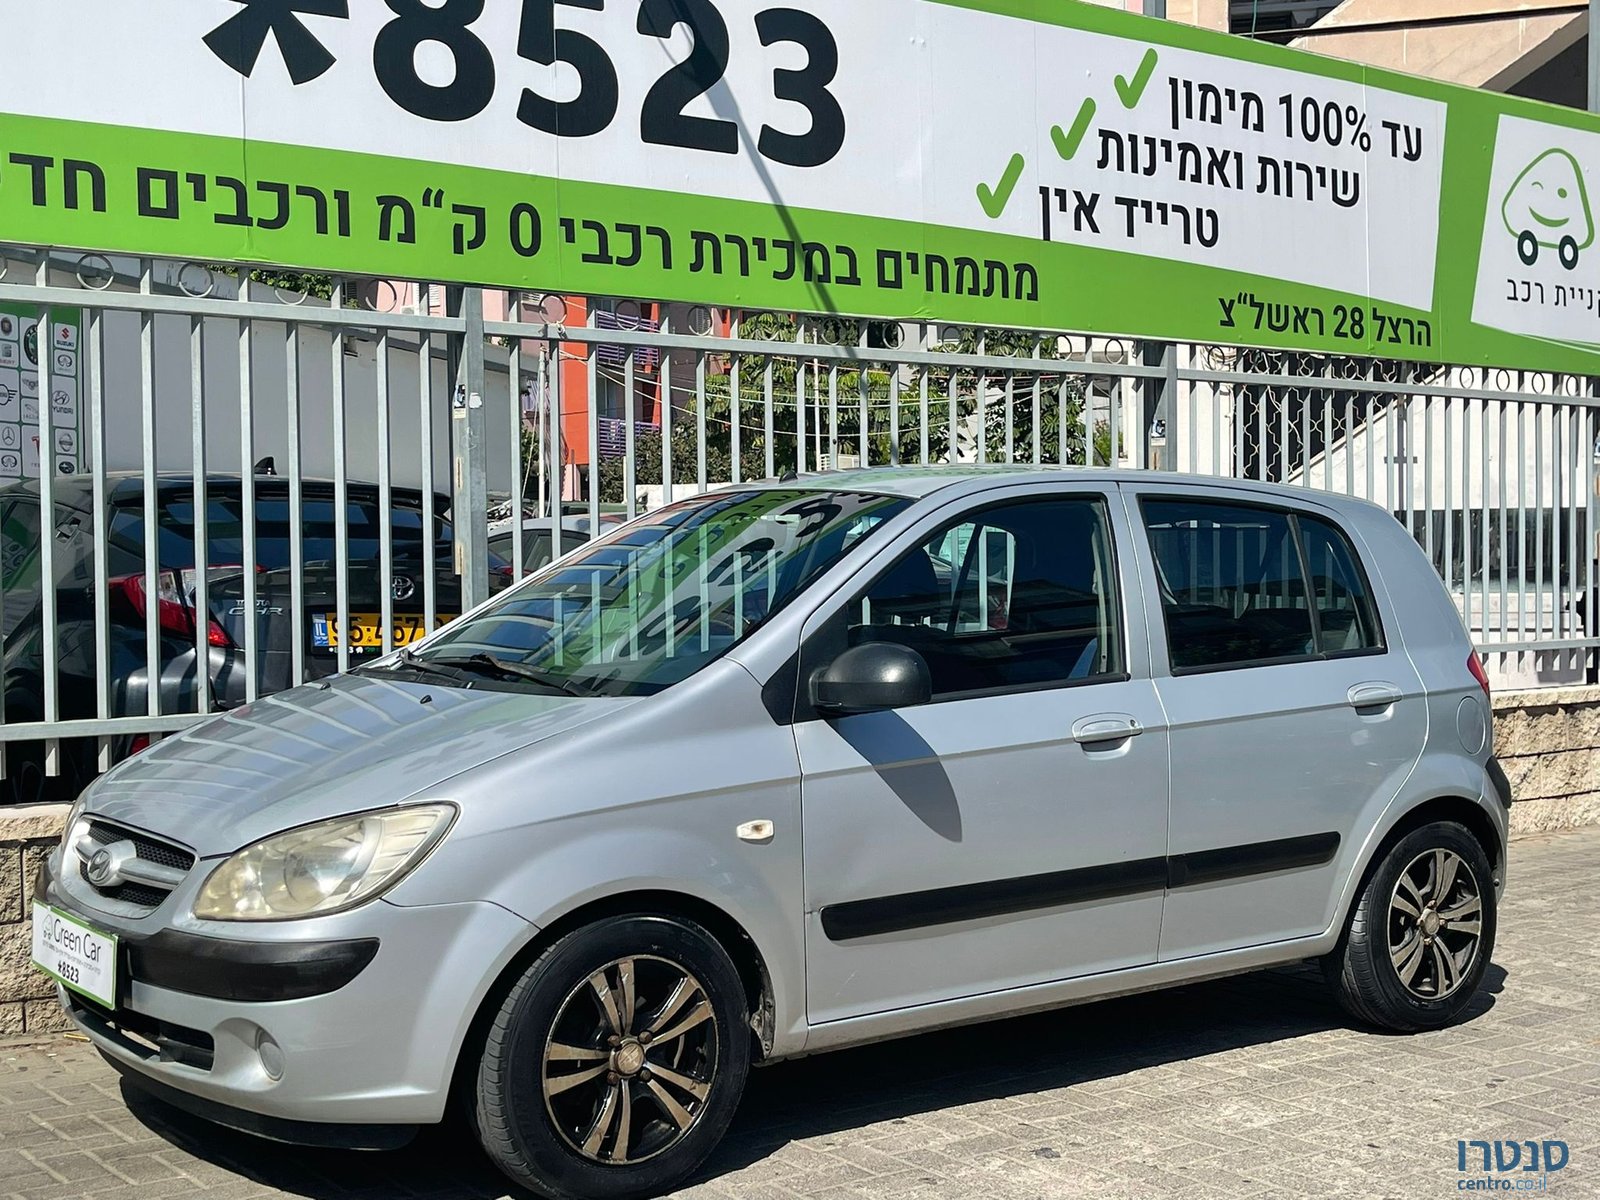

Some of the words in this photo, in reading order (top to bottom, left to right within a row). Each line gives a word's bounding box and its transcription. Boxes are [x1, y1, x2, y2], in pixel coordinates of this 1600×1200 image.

[1168, 76, 1265, 132] מימון
[1278, 93, 1371, 153] 100%
[1097, 128, 1244, 190] ואמינות
[1381, 120, 1422, 161] עד
[0, 152, 106, 213] חד
[137, 167, 350, 237] ורכבים
[1256, 155, 1360, 207] שירות
[509, 202, 542, 257] 0
[1038, 185, 1101, 241] אין
[1114, 196, 1219, 248] טרייד
[559, 217, 672, 270] רכבי
[690, 230, 861, 286] במכירת
[876, 248, 1039, 301] מתמחים
[1507, 278, 1544, 304] רכב
[1333, 304, 1365, 340] 28
[1372, 307, 1431, 347] הרצל
[1554, 285, 1600, 318] ניית
[315, 623, 326, 637] IL
[54, 919, 81, 954] Green
[83, 933, 101, 962] Car
